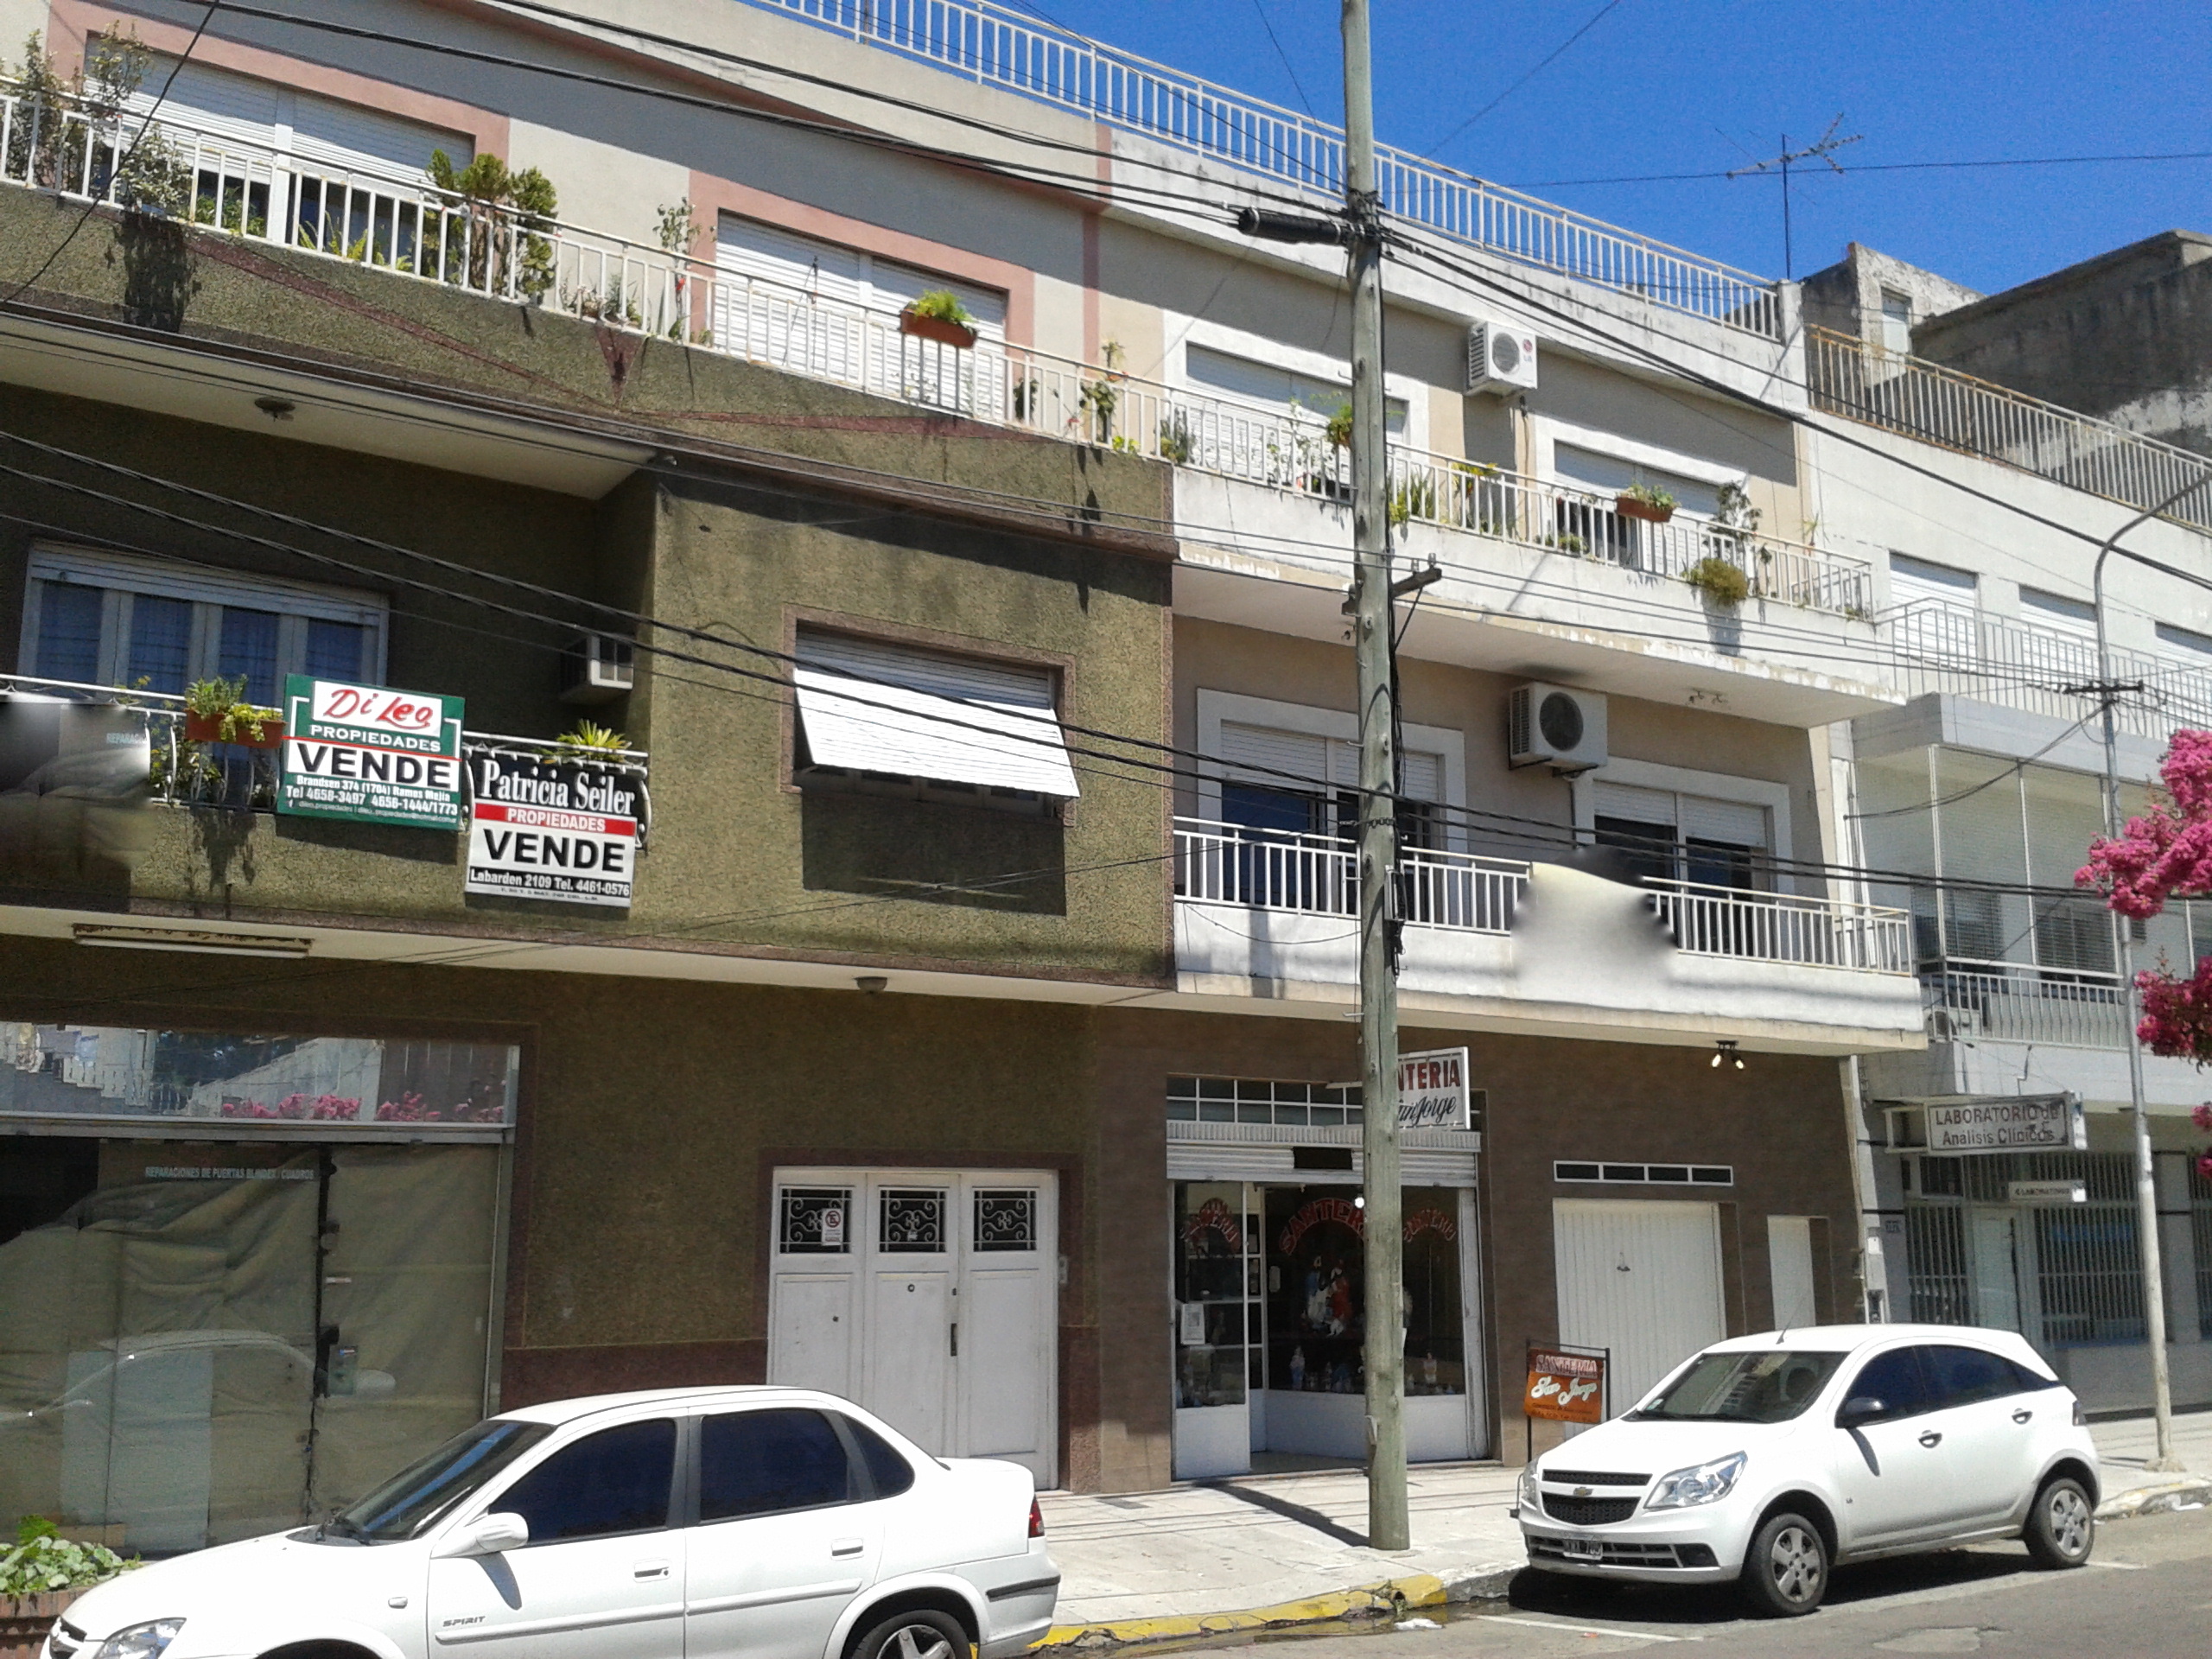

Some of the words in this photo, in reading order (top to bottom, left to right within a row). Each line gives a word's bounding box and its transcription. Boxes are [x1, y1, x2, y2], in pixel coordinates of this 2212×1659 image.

[323, 689, 378, 719] Di
[375, 696, 434, 730] Leo
[309, 724, 442, 753] PROPIEDADES
[296, 742, 452, 789] VENDE
[286, 785, 304, 798] Tel
[296, 774, 340, 789] Brandsen
[342, 779, 359, 792] 374
[480, 759, 569, 808] Patricia
[574, 772, 635, 815] Seiler
[506, 807, 607, 833] PROPIEDADES
[483, 828, 626, 873] VENDE
[470, 868, 523, 887] Labarden
[524, 874, 551, 888] 2109
[554, 877, 574, 890] Tel.
[576, 879, 630, 897] 4461-0576
[1936, 1103, 2037, 1125] LABORATORIO
[442, 1615, 486, 1627] SPIRIT
